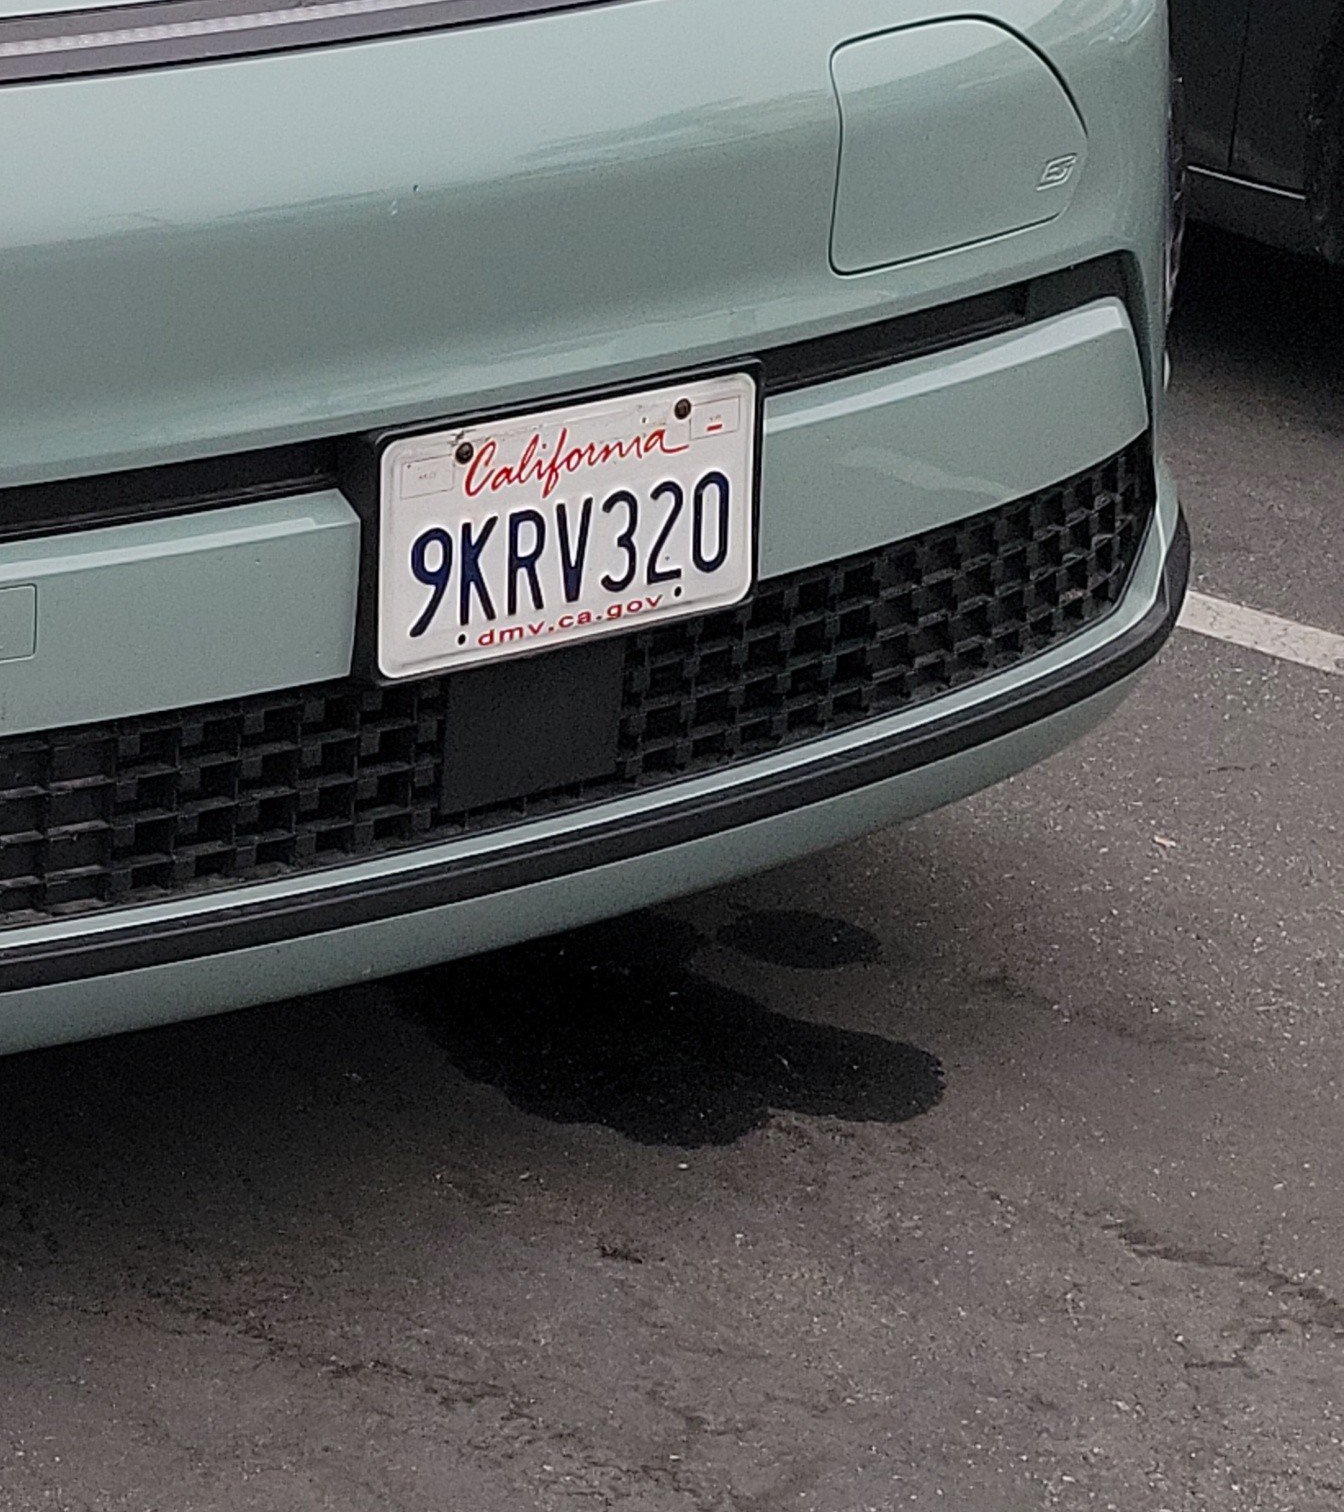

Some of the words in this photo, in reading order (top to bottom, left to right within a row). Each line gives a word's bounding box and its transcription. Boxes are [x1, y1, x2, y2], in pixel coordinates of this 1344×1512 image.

[464, 427, 689, 499] California
[409, 470, 730, 638] 9KRV320
[477, 593, 664, 647] dmv.ca.gov
